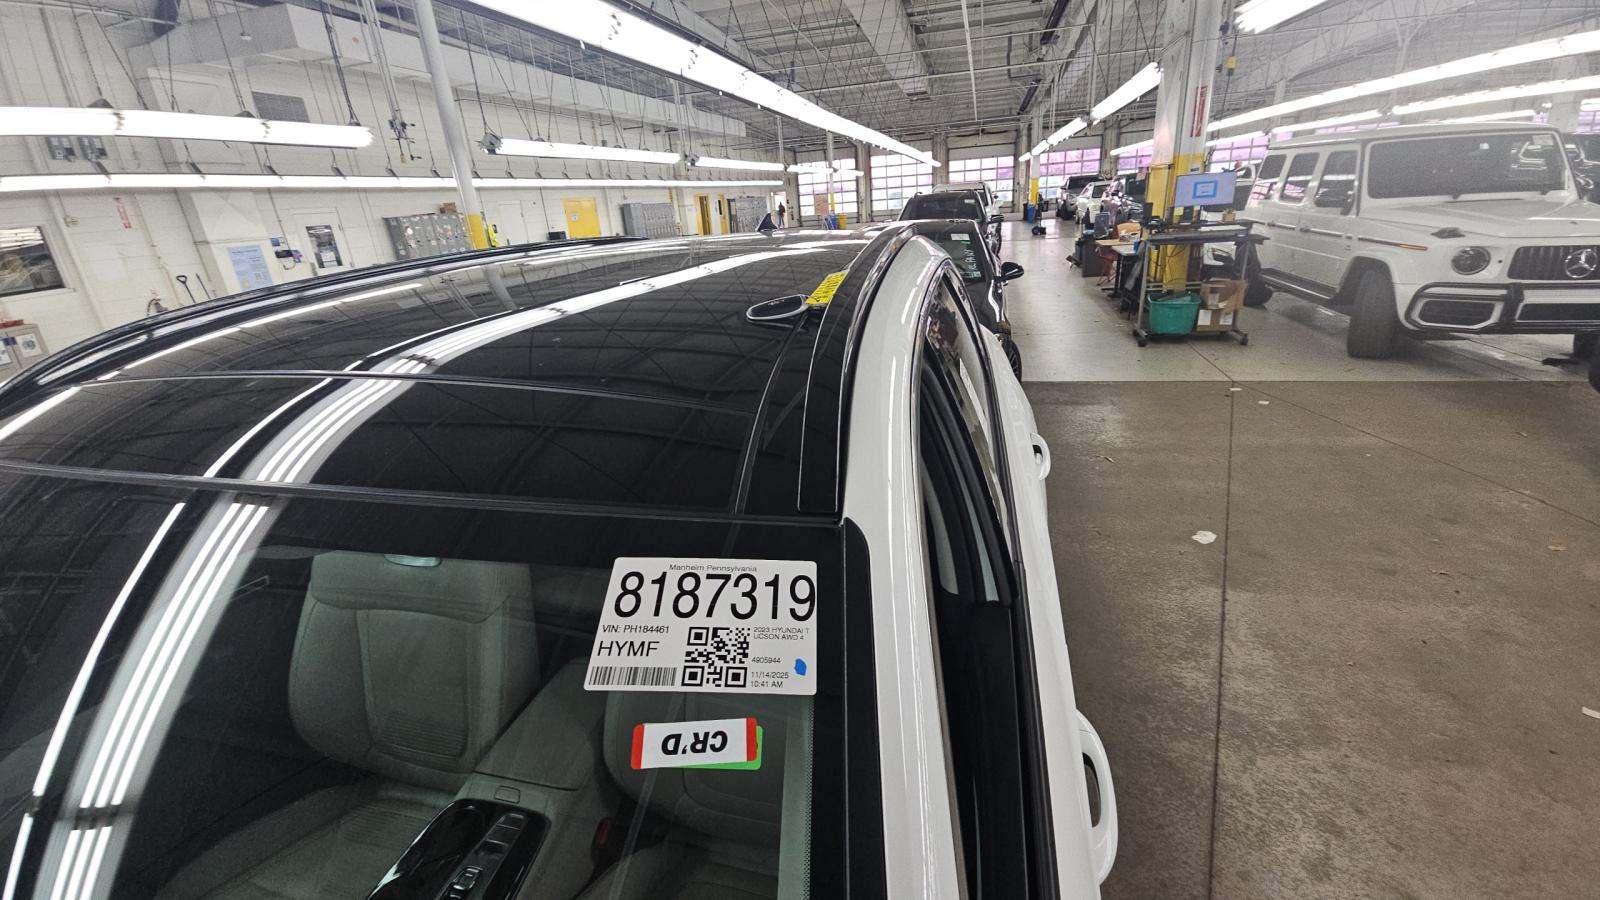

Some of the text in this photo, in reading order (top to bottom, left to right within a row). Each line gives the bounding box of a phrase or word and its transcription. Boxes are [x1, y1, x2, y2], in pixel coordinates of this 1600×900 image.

[706, 564, 758, 573] Pennsylvania
[614, 571, 816, 622] 8187319
[602, 624, 669, 634] VIN: PH184461
[771, 626, 804, 634] HYUNDAI
[781, 633, 799, 641] AWD
[597, 640, 660, 657] HYMF
[751, 671, 789, 679] 11/14/2025
[750, 680, 784, 688] 10:41 AM
[661, 730, 728, 756] CR'D
